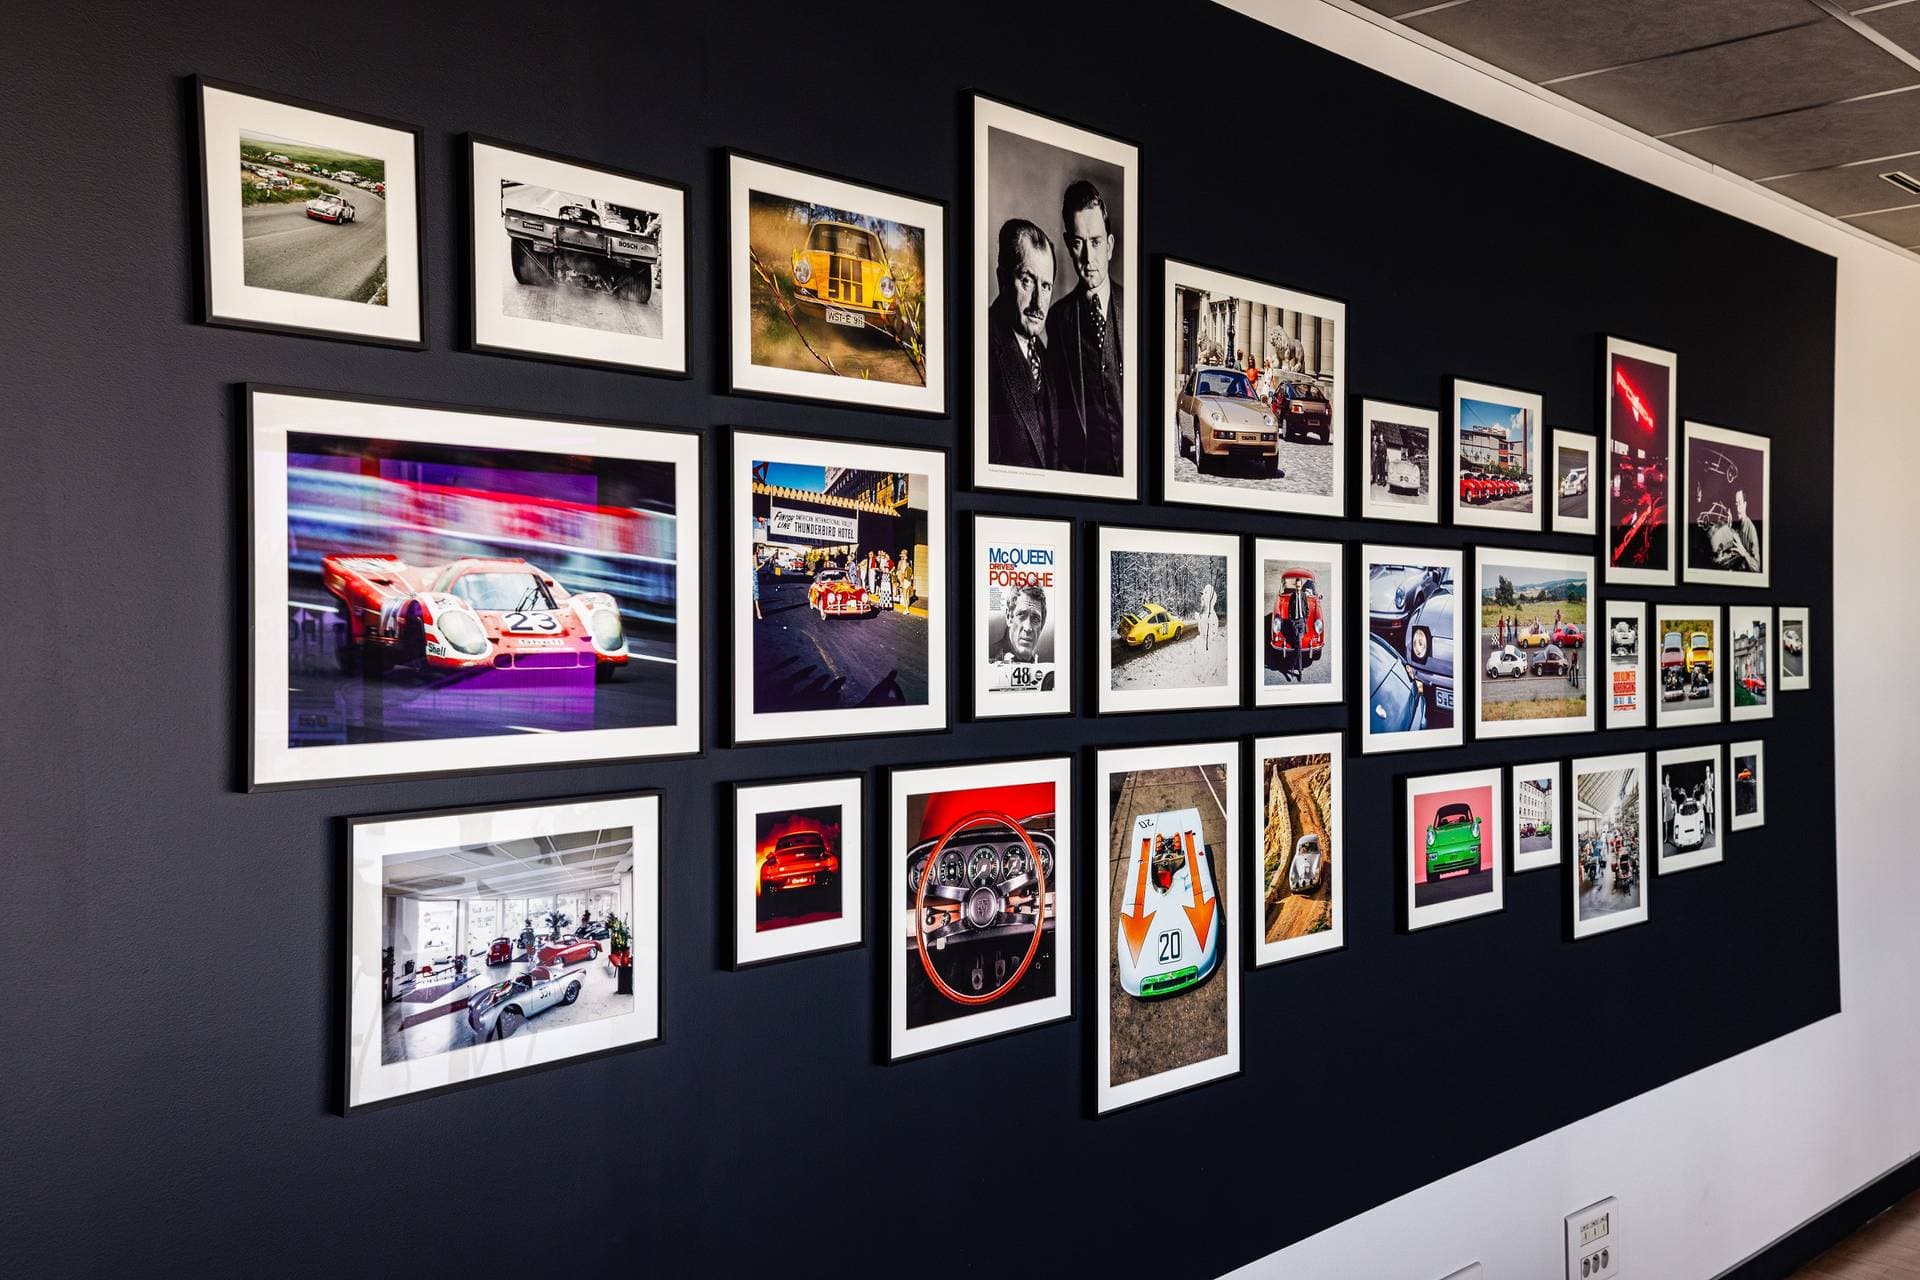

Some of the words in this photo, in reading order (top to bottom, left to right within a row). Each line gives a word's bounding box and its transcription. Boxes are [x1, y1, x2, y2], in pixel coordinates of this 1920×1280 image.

[618, 240, 639, 250] BOSCH
[777, 521, 792, 530] LINE
[795, 521, 836, 538] THUNDERBIRD
[837, 527, 854, 540] HOTEL
[989, 547, 1054, 568] McQUEEN
[989, 563, 1015, 571] DRIVES
[989, 570, 1054, 588] PORSCHE
[504, 612, 558, 632] 23
[428, 642, 447, 657] Shell
[1012, 667, 1030, 685] 48
[1159, 930, 1182, 962] 20
